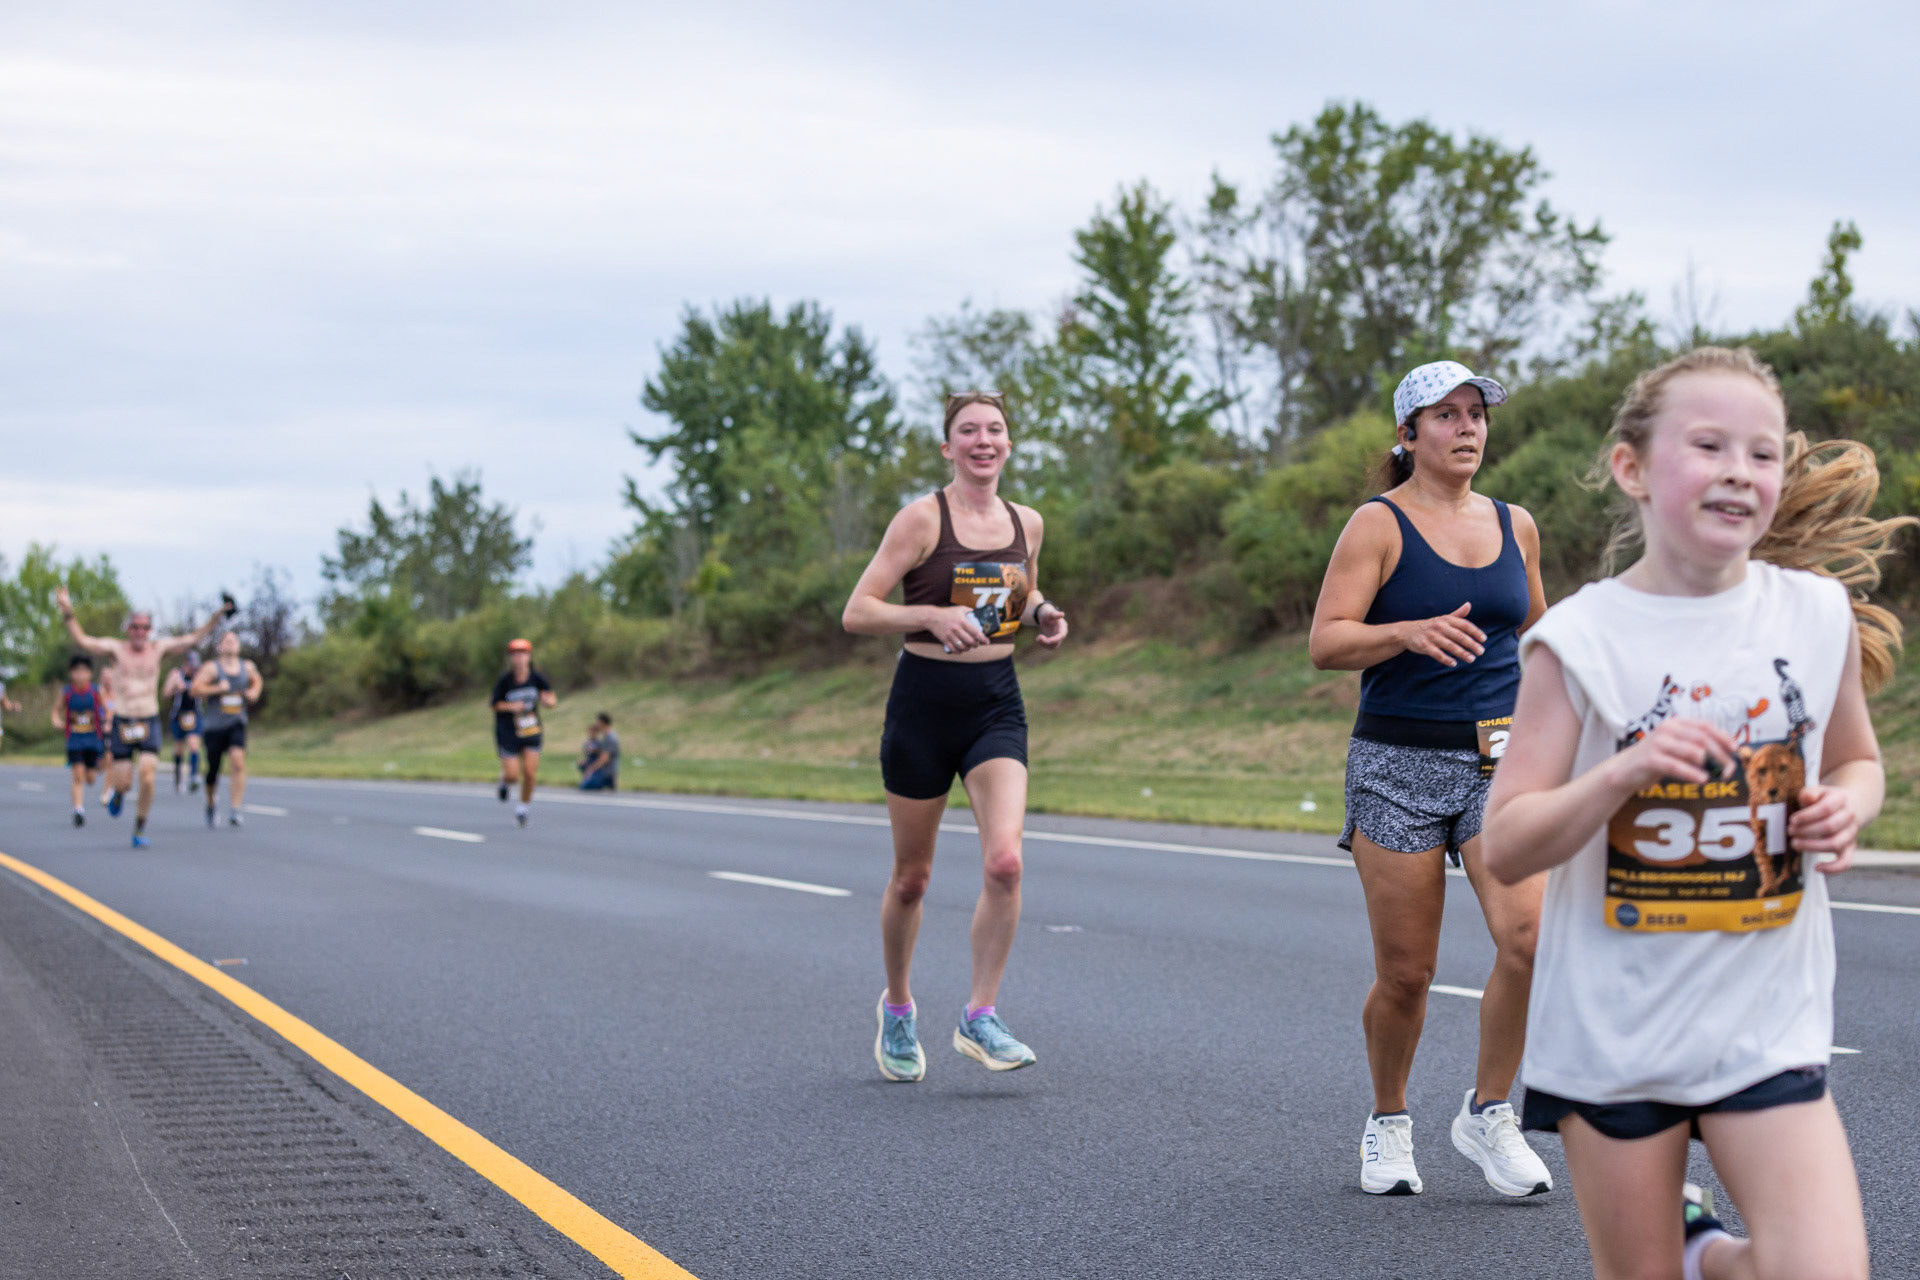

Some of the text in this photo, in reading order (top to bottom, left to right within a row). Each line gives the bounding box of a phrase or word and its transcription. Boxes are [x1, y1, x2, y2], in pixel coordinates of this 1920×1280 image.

[972, 587, 1012, 609] 77
[1703, 781, 1739, 799] 5K
[1633, 801, 1787, 862] 351
